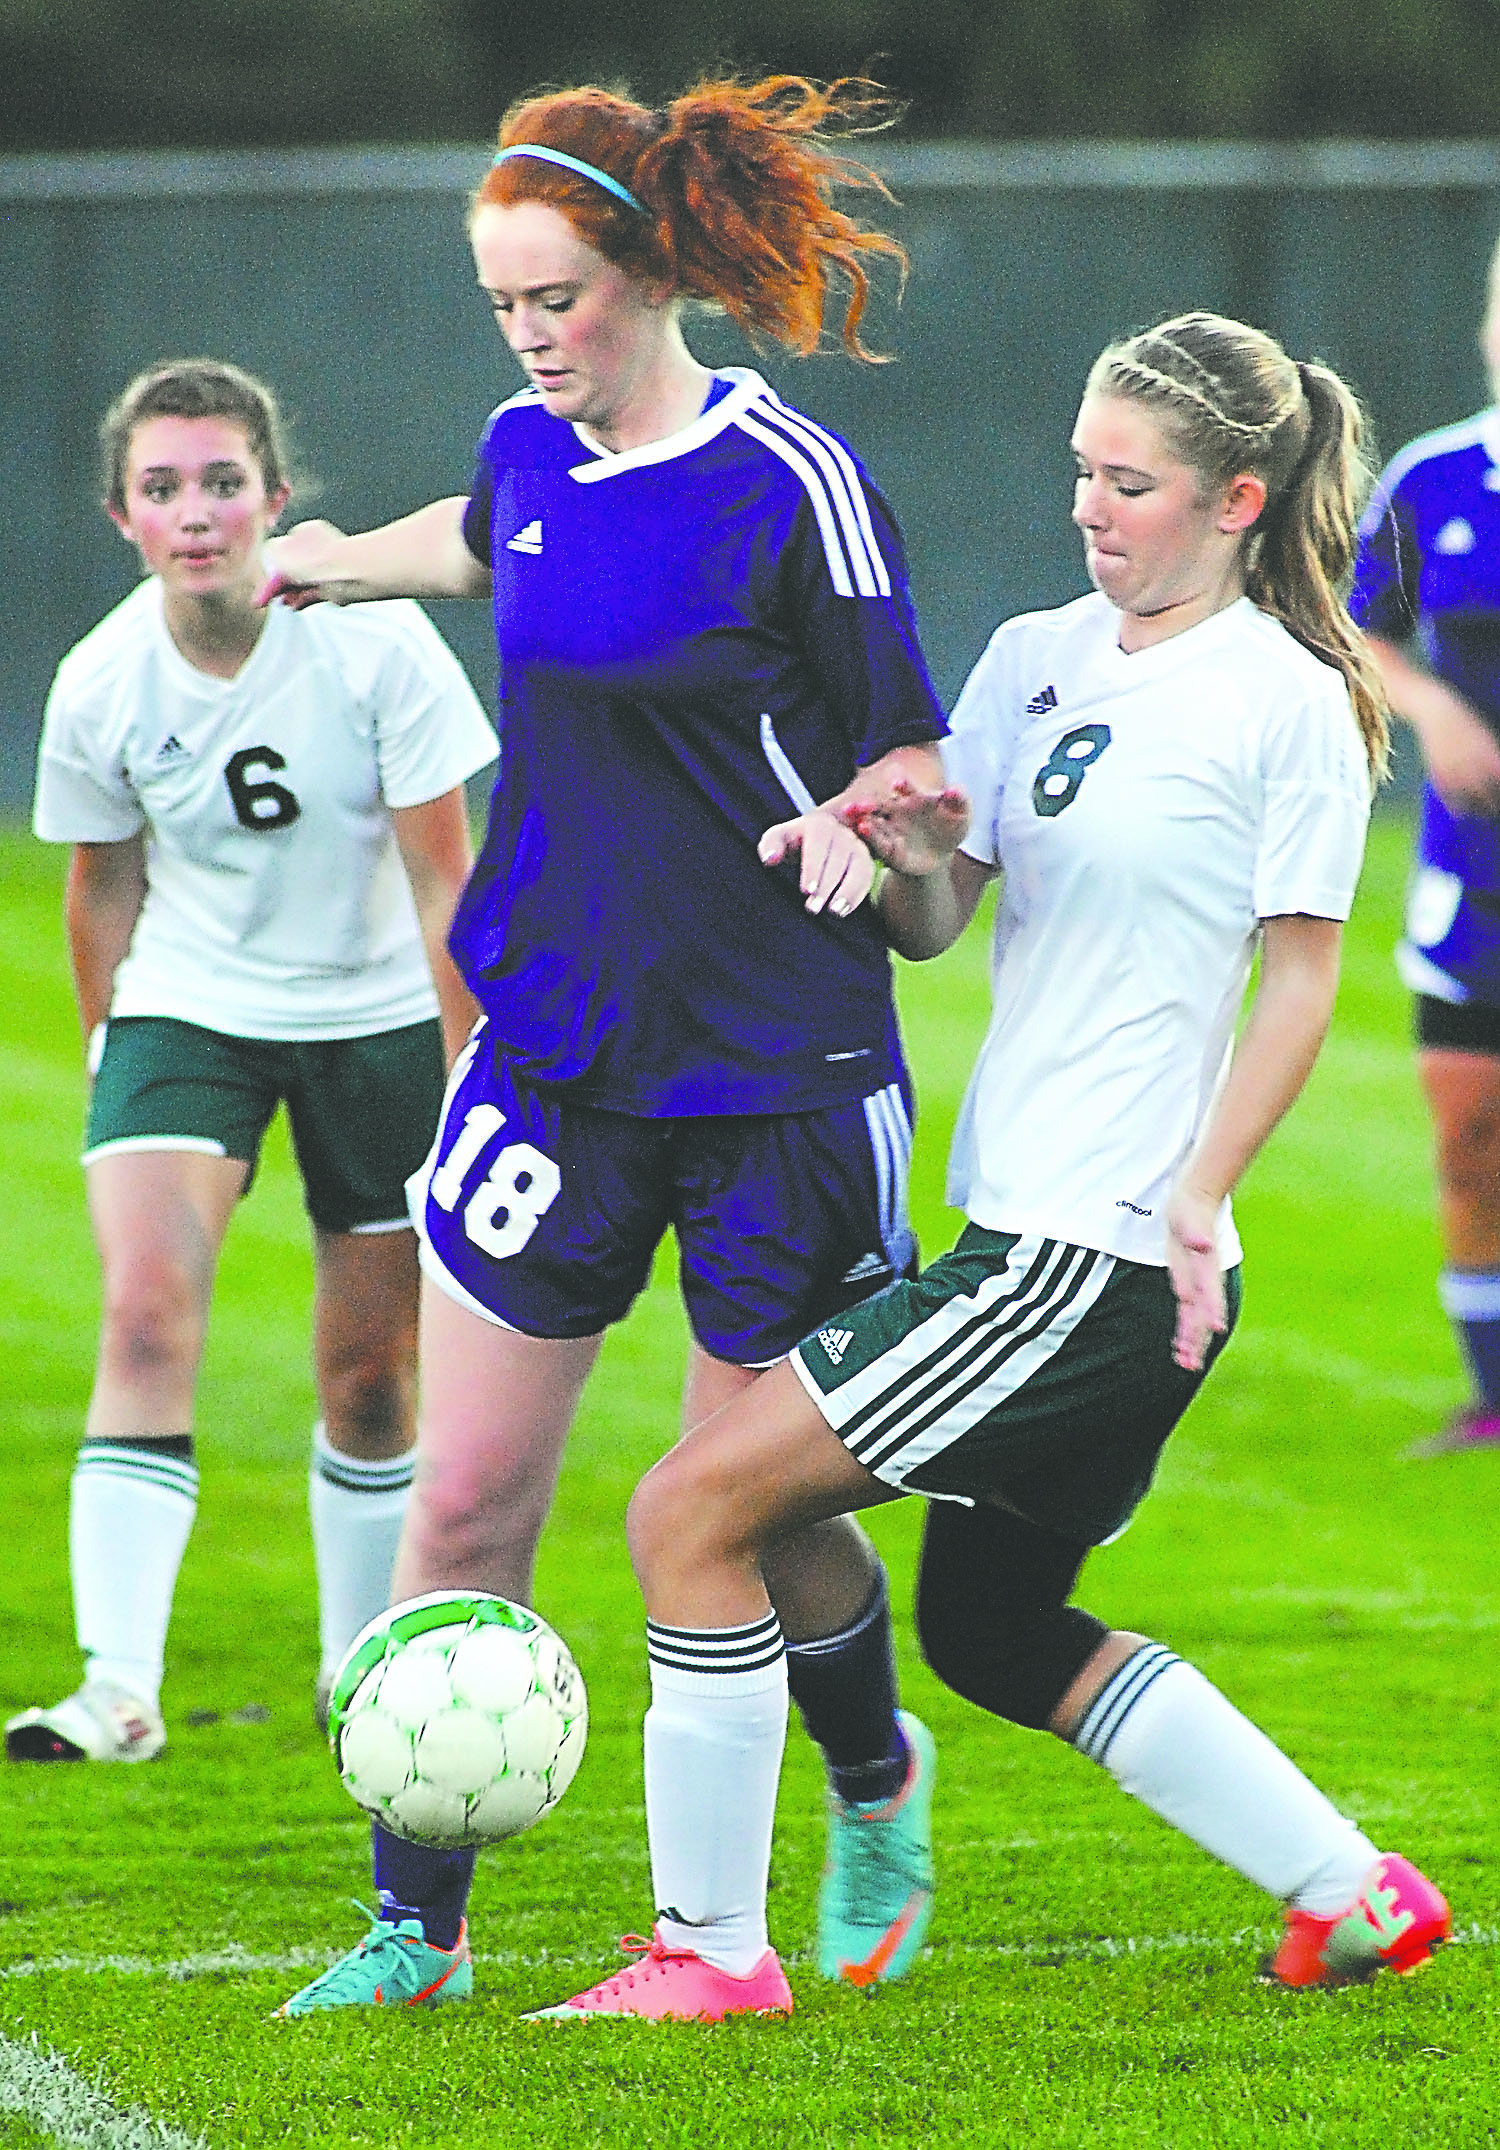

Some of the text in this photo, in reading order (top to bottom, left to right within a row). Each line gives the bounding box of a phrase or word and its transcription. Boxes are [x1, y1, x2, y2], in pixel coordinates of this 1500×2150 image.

[224, 745, 302, 831] 6
[1032, 724, 1111, 817] 8
[430, 1103, 562, 1259] 18
